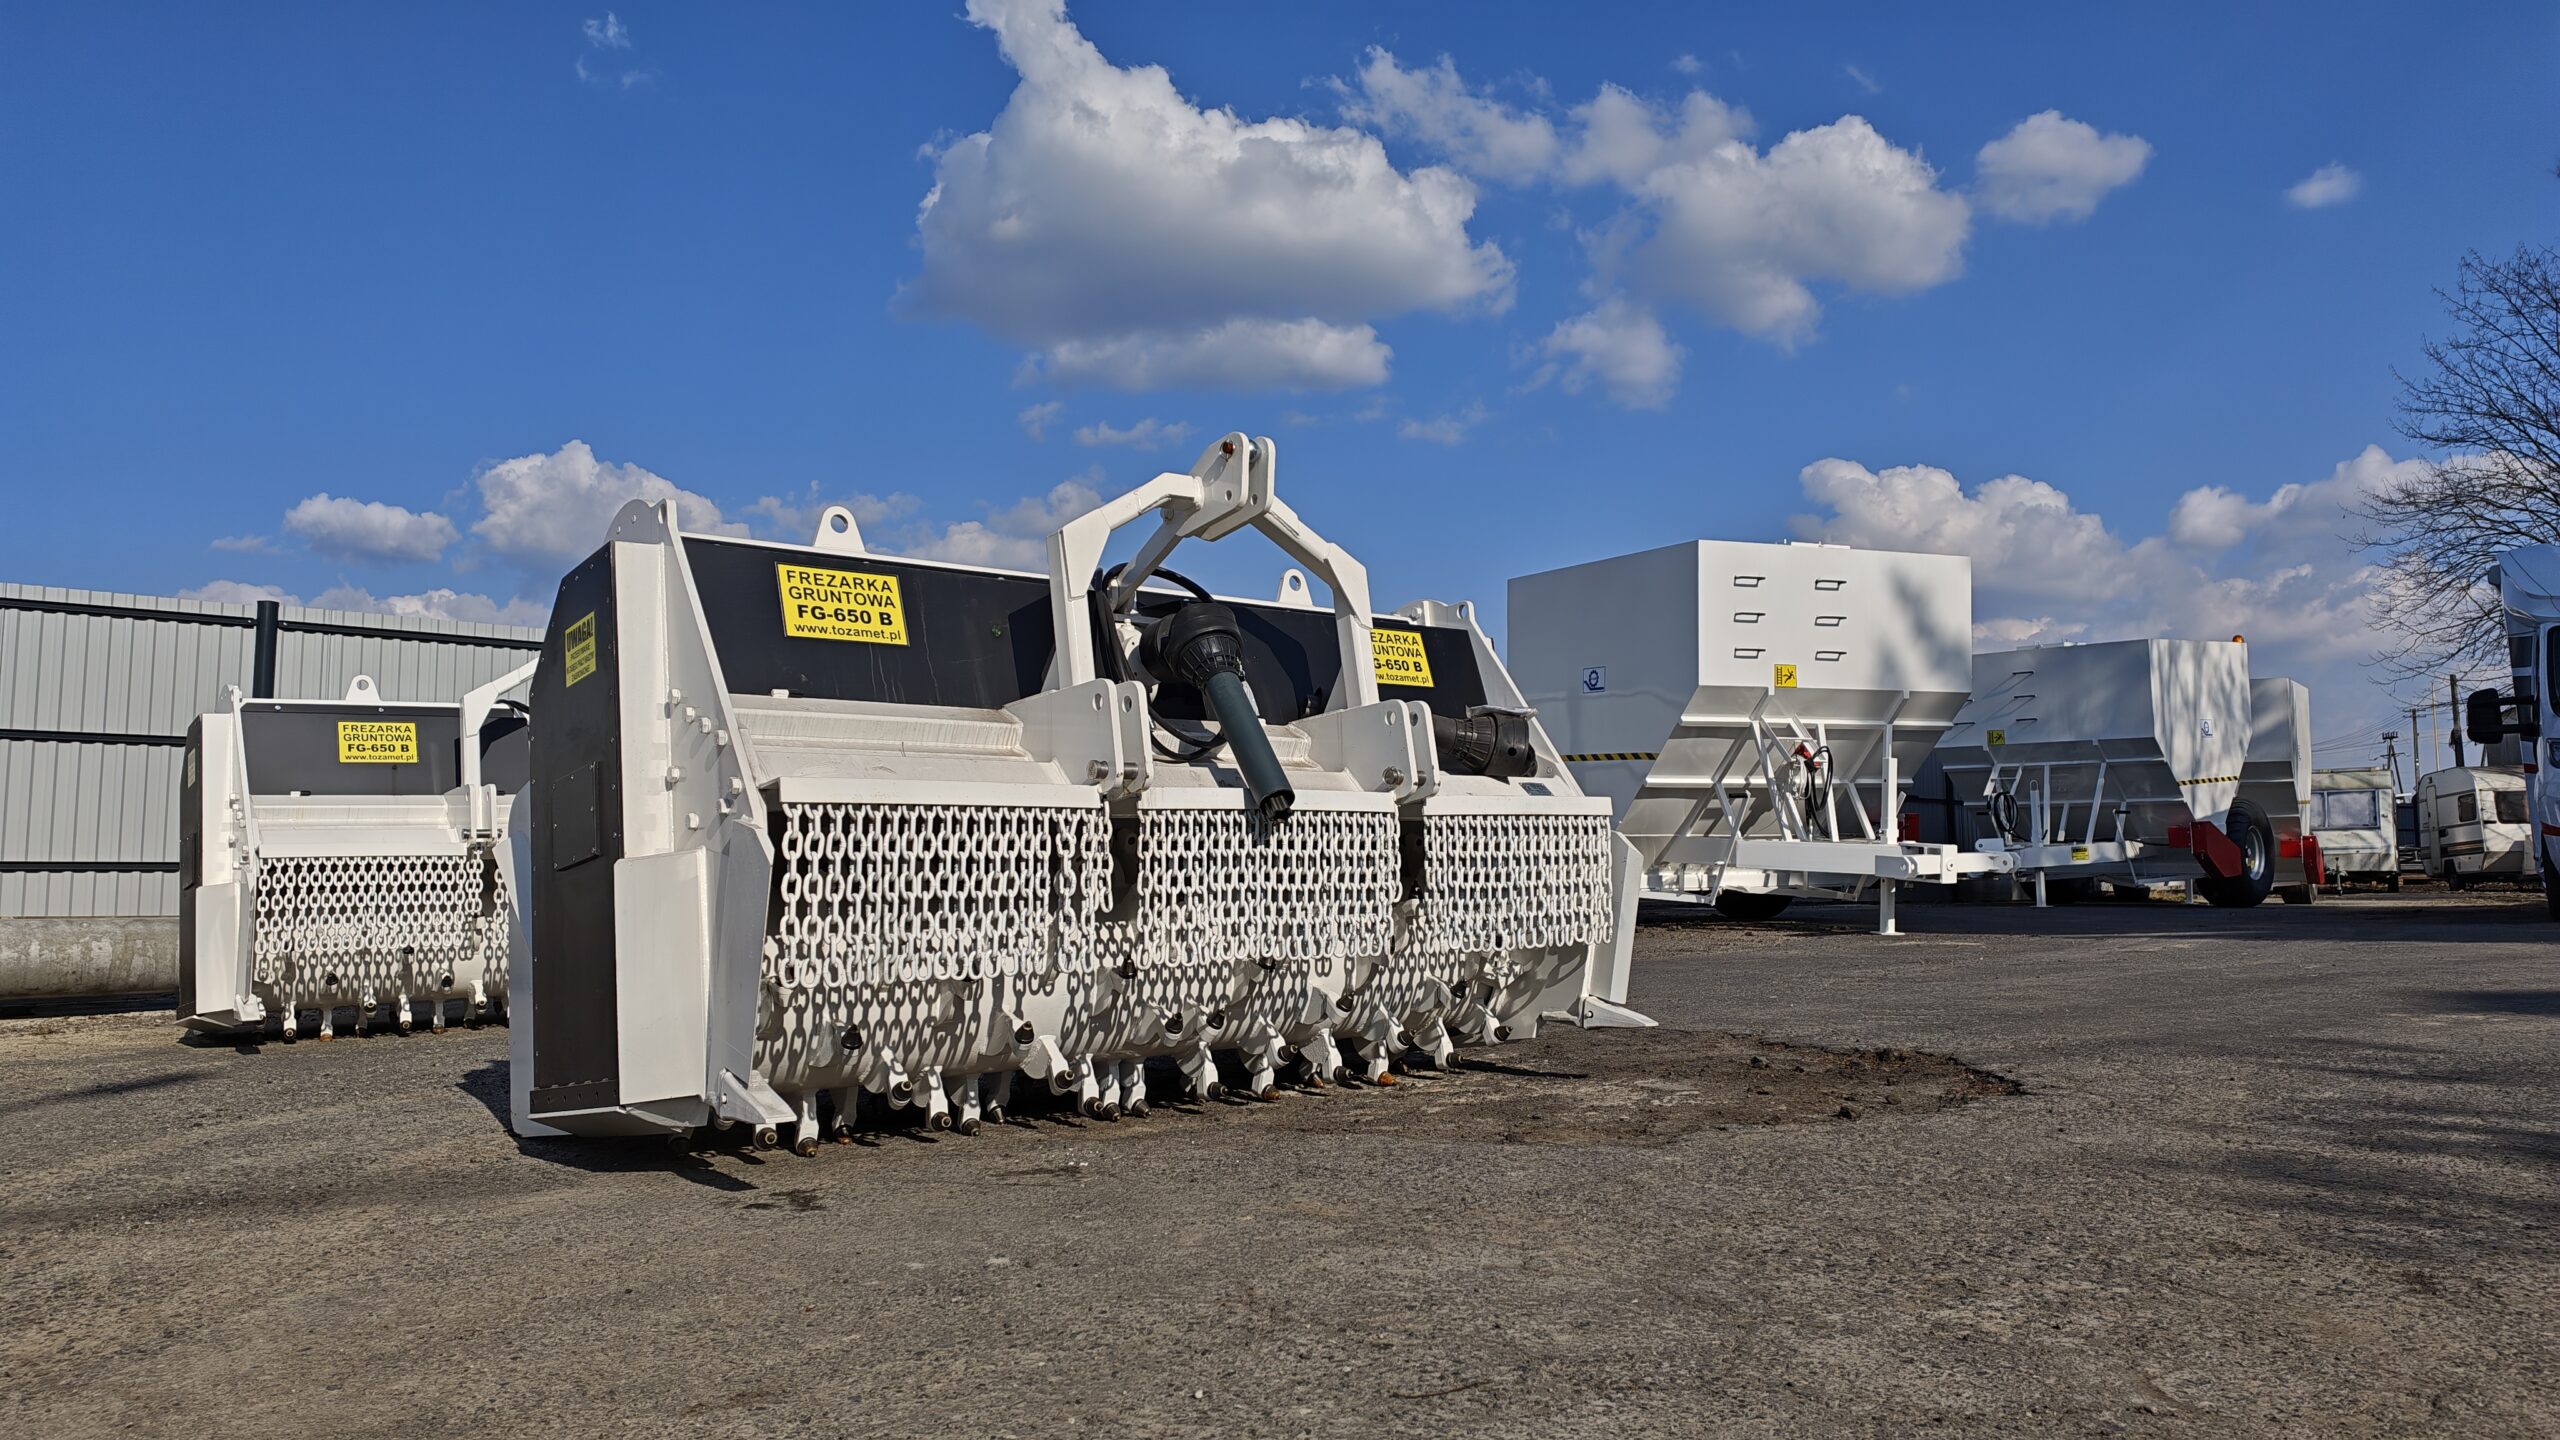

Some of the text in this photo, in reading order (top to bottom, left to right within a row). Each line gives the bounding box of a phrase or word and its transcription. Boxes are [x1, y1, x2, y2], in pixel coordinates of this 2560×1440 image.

[786, 570, 893, 593] FREZARKA
[788, 586, 896, 608] GRUNTOWA
[797, 604, 893, 626] FG-650 B
[566, 616, 594, 652] UWAGA!
[794, 624, 901, 641] www.tozamet.pl
[1372, 644, 1424, 658] UNTOWA
[1413, 661, 1423, 672] B
[343, 724, 412, 733] FREZARKA
[343, 733, 413, 742] GRUNTOWA
[347, 744, 410, 752] FG-650 B
